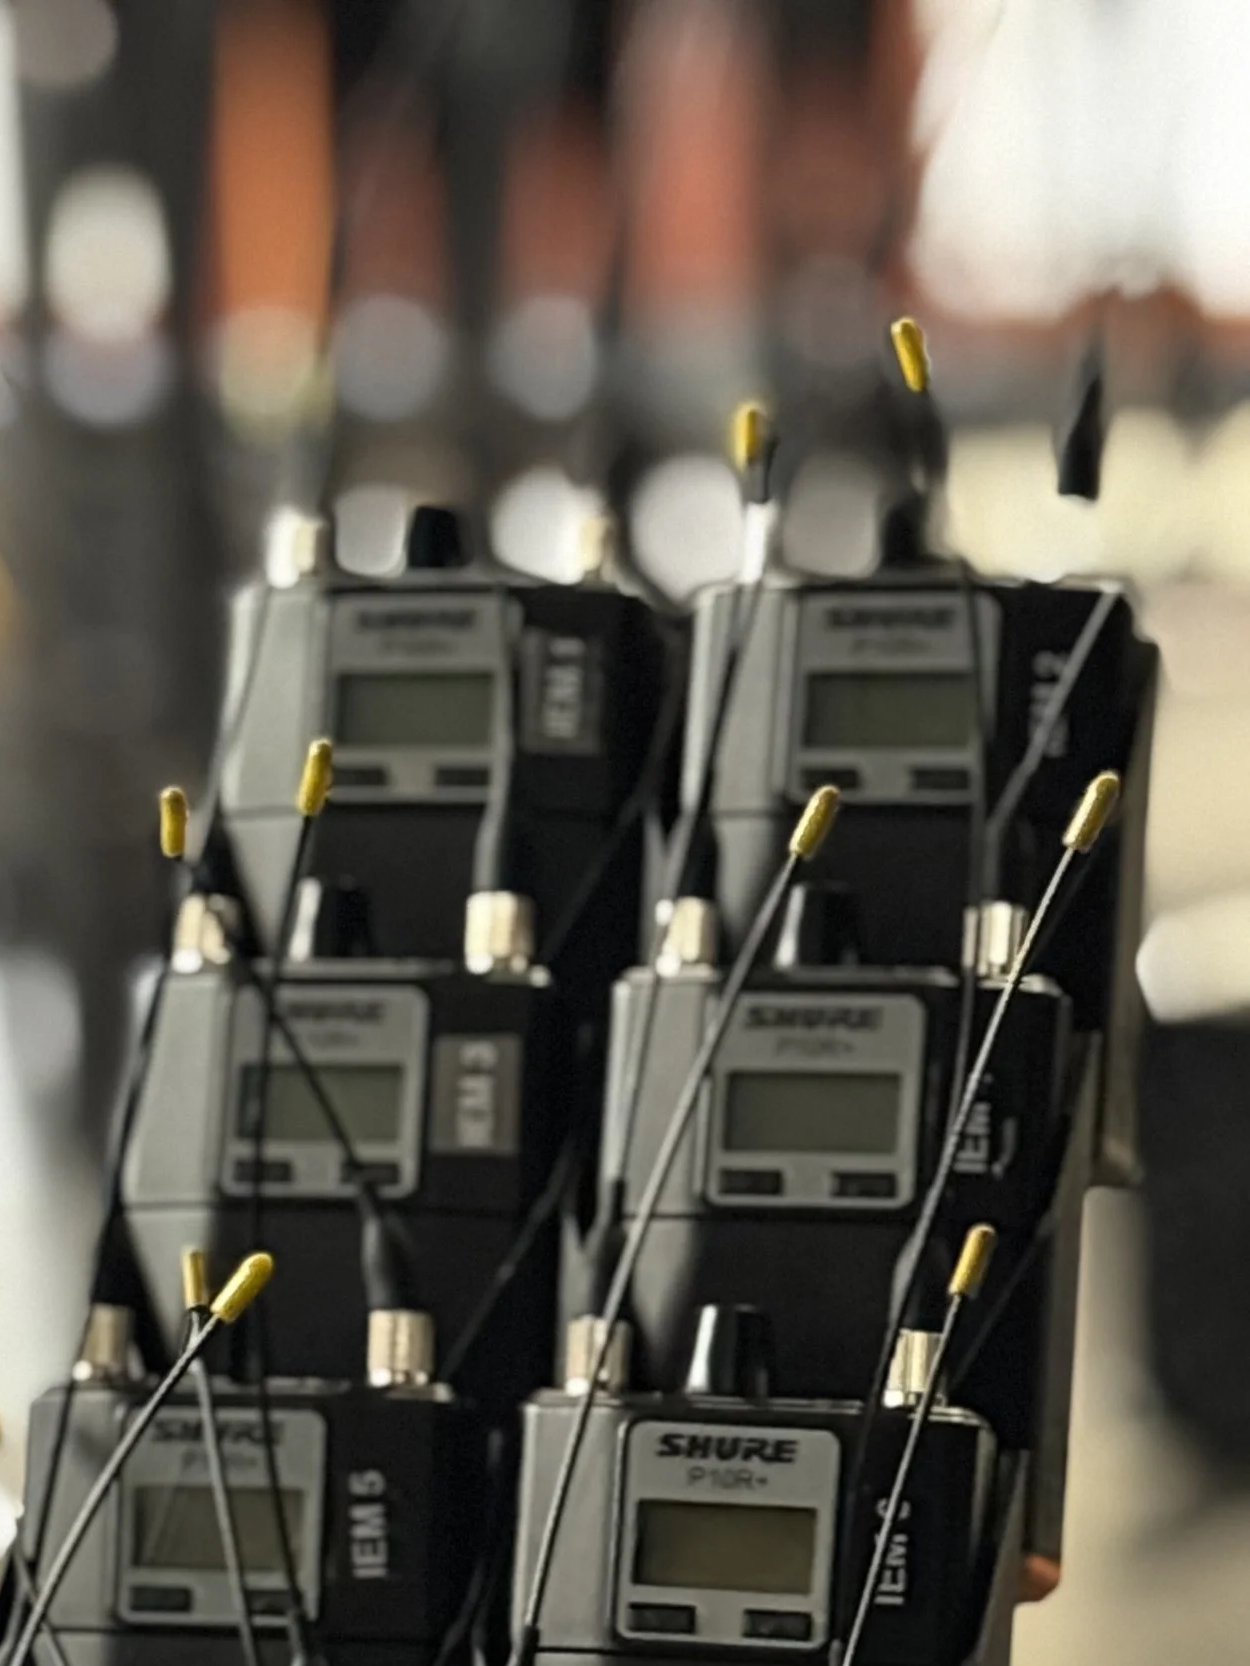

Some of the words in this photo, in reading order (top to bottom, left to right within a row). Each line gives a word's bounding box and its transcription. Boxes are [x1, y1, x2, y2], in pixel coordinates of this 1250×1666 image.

[656, 1432, 799, 1463] SHURE
[350, 1468, 387, 1497] 5
[349, 1503, 388, 1579] IEM
